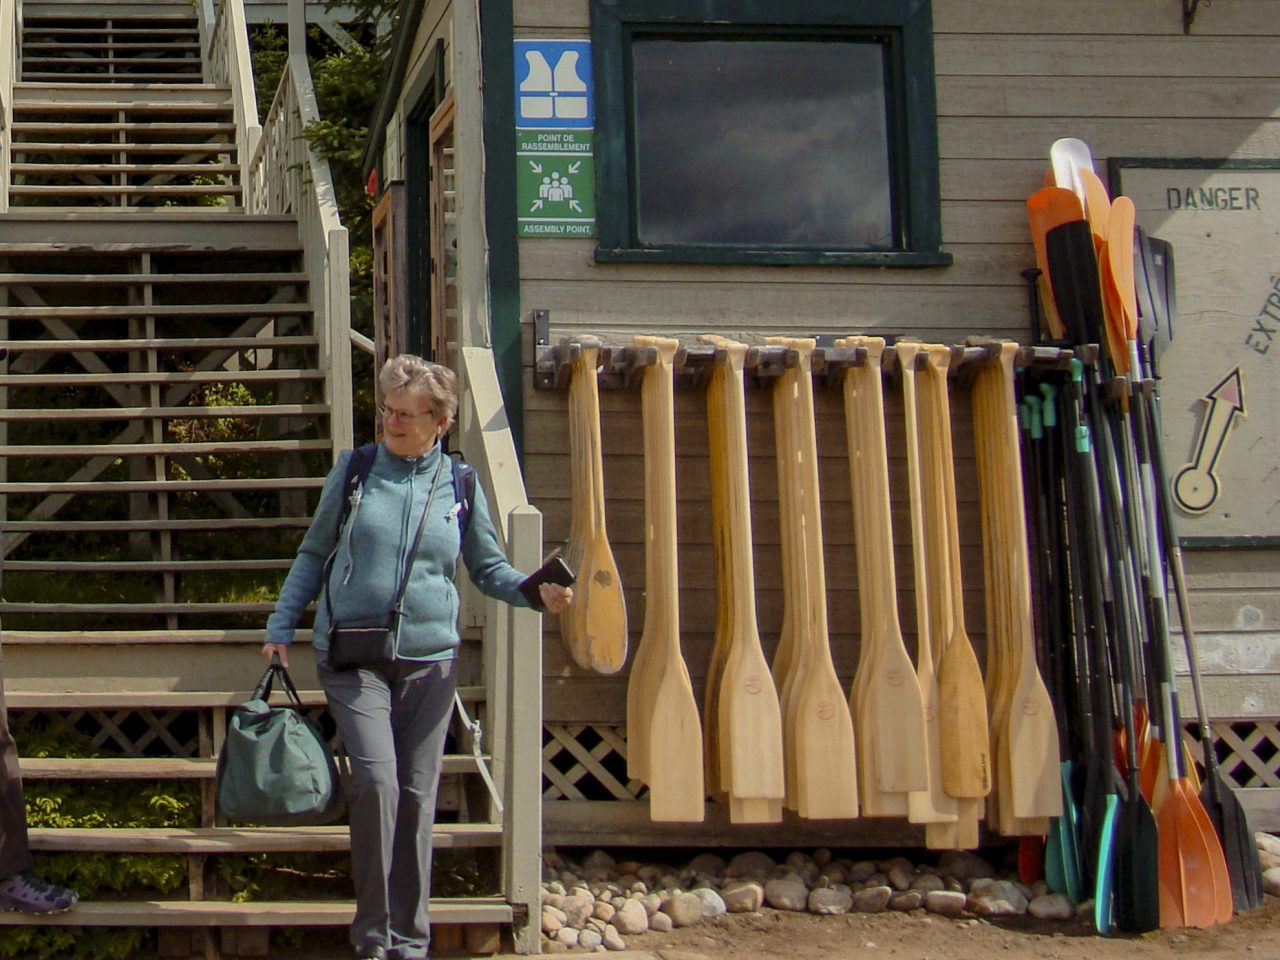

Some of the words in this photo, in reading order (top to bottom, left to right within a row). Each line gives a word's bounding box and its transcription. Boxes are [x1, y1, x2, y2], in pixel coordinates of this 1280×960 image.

[537, 133, 561, 142] POINT
[563, 134, 575, 142] DE
[521, 142, 591, 151] RASSEMBLEMENT
[1166, 187, 1262, 211] DANGER
[523, 224, 565, 233] ASSEMBLY
[566, 224, 591, 233] POINT
